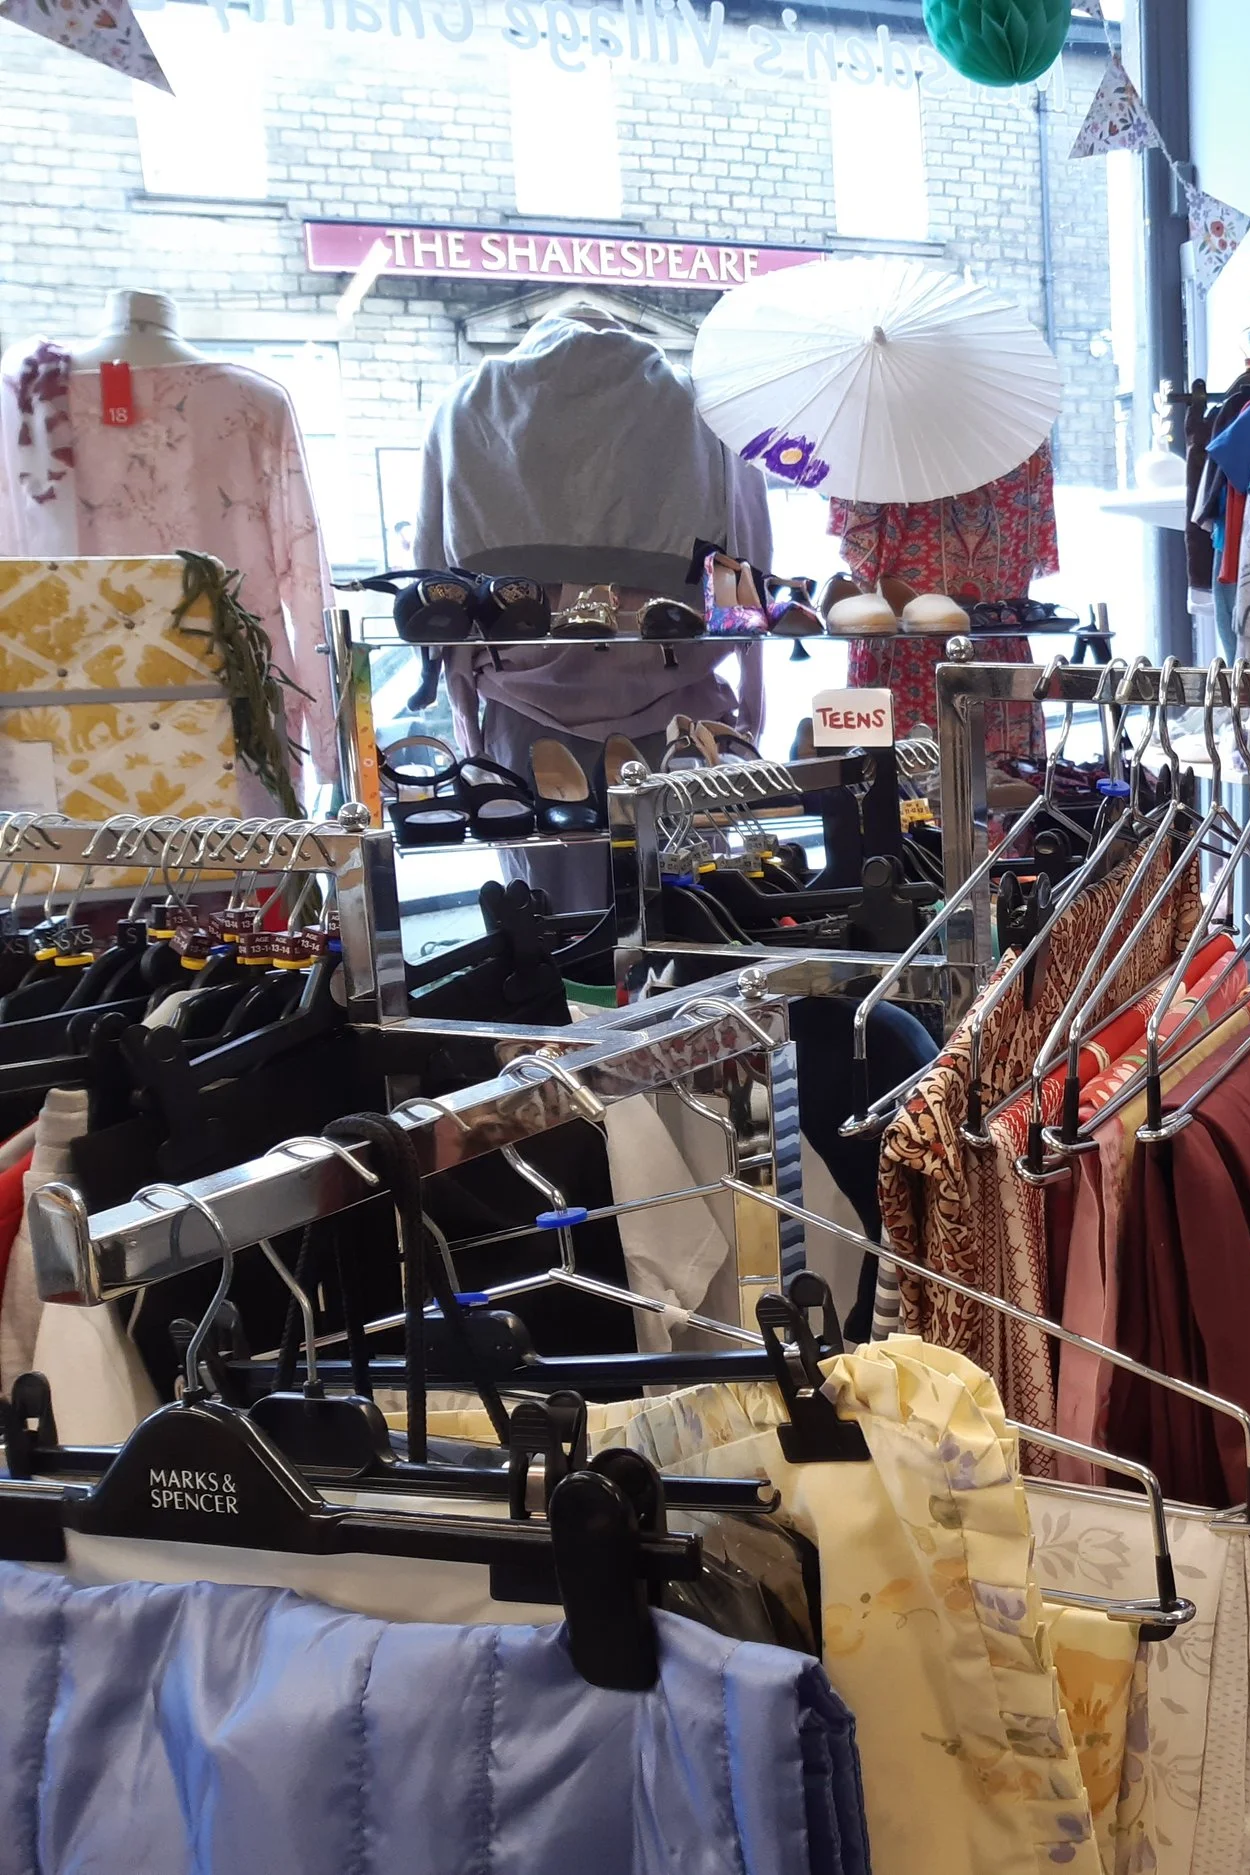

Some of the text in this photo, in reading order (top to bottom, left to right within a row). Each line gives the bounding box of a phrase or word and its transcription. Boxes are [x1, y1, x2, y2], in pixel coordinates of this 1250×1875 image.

[386, 229, 759, 283] THE SHAKESPEARE
[108, 407, 128, 423] 18
[815, 707, 886, 730] TEENS
[71, 928, 93, 945] XS
[125, 927, 138, 943] S
[271, 944, 290, 954] 13-14
[301, 939, 320, 951] 13-14
[149, 1468, 236, 1493] MARKS &
[150, 1488, 239, 1514] SPENCER
